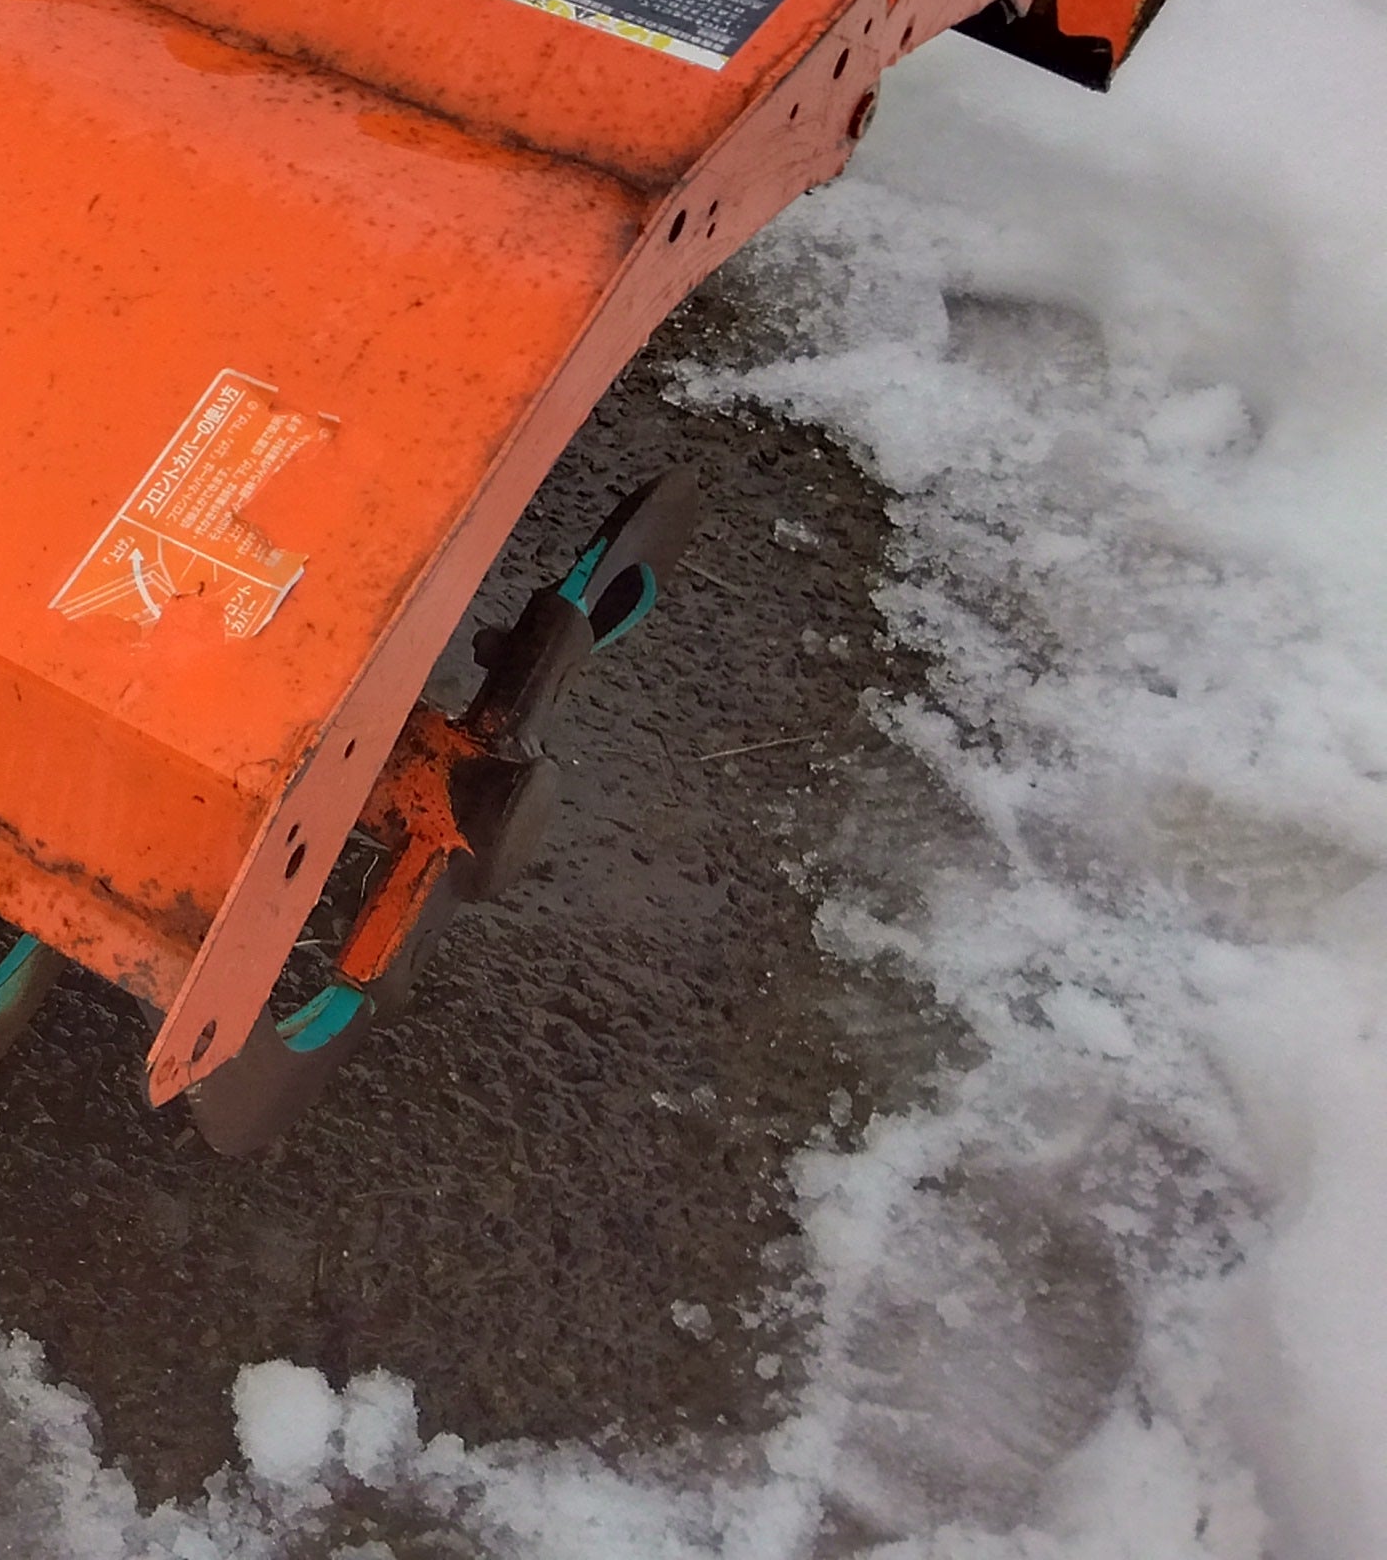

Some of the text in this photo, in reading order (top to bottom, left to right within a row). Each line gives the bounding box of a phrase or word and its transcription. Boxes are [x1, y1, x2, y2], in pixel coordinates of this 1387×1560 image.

[137, 384, 241, 515] フロントカバーの使い方
[229, 598, 258, 633] カバー
